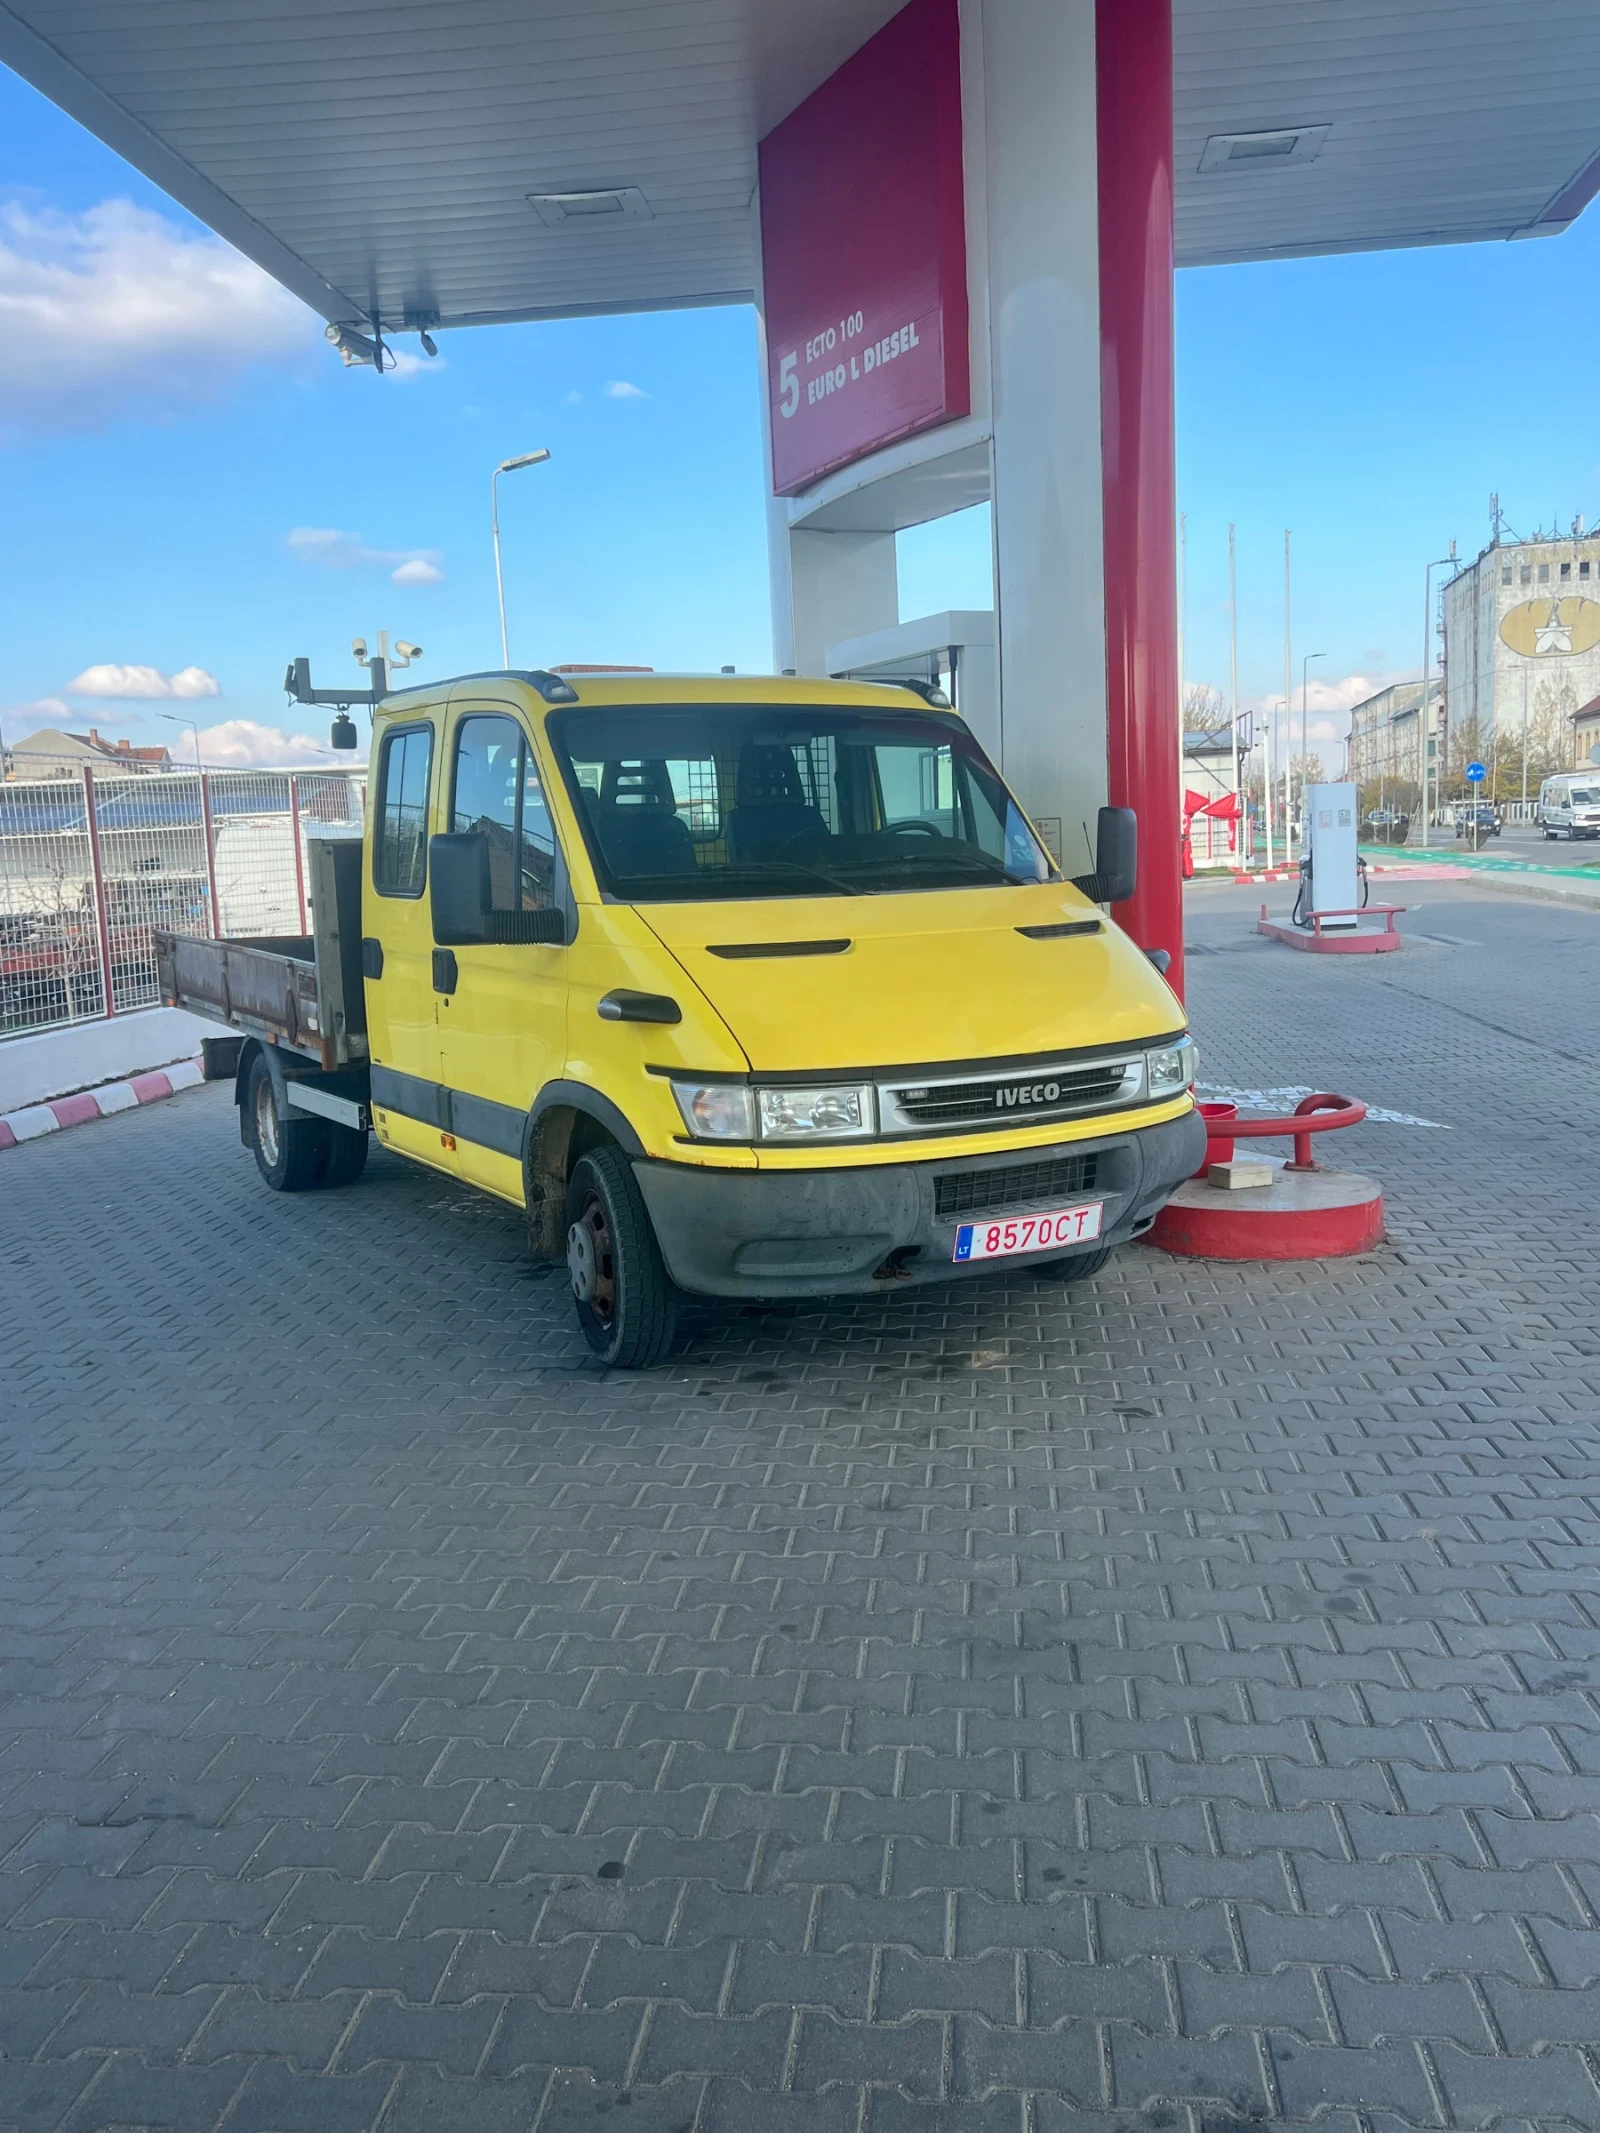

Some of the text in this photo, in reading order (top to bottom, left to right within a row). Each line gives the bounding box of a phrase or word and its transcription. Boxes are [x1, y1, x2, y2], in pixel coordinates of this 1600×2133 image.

[805, 310, 863, 364] ECTO 100
[779, 350, 800, 419] 5
[807, 322, 920, 405] EURO L DIESEL
[996, 1082, 1060, 1107] IVECO
[958, 1245, 970, 1255] LT
[985, 1210, 1089, 1253] 8570CT
